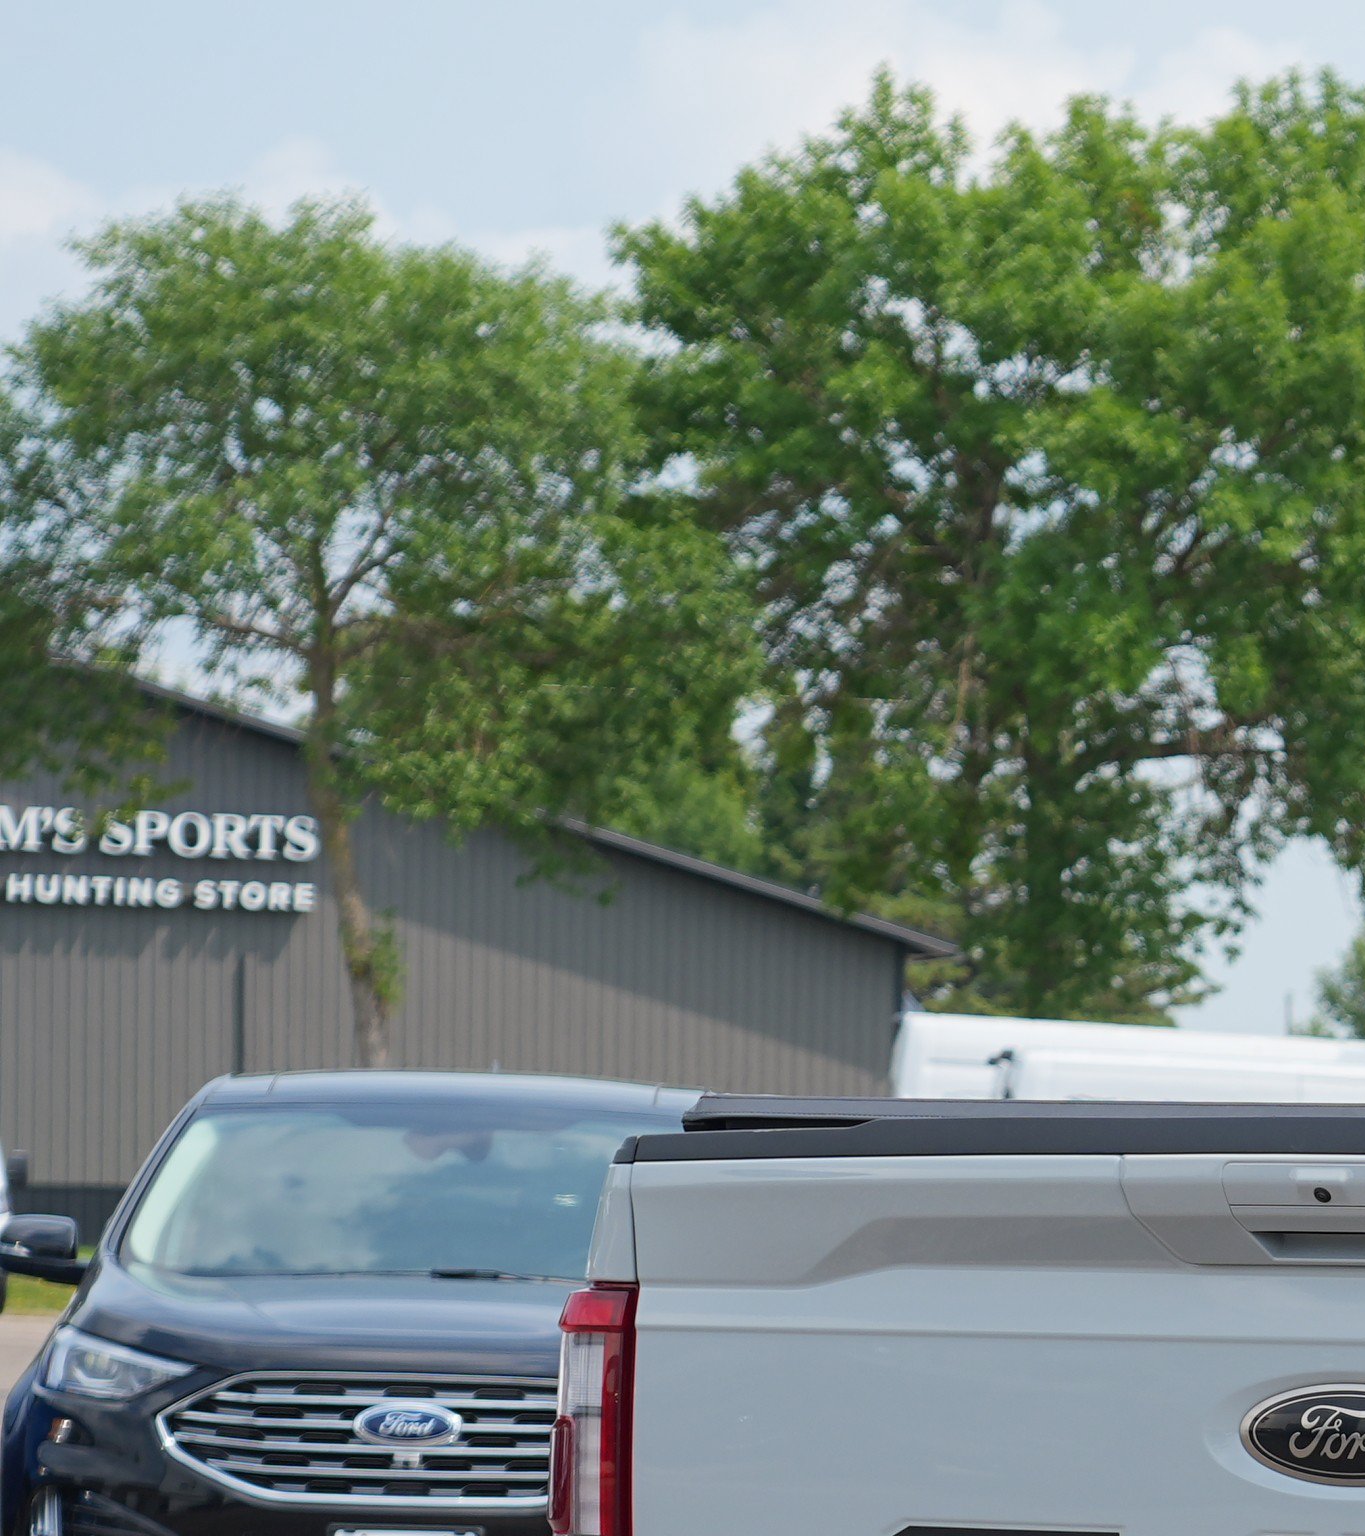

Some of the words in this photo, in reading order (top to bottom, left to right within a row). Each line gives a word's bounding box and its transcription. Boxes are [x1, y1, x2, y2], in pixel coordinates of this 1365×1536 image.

[99, 808, 322, 862] SPORTS
[6, 872, 184, 908] HUNTING
[193, 879, 318, 913] STORE
[378, 1411, 436, 1437] Ford
